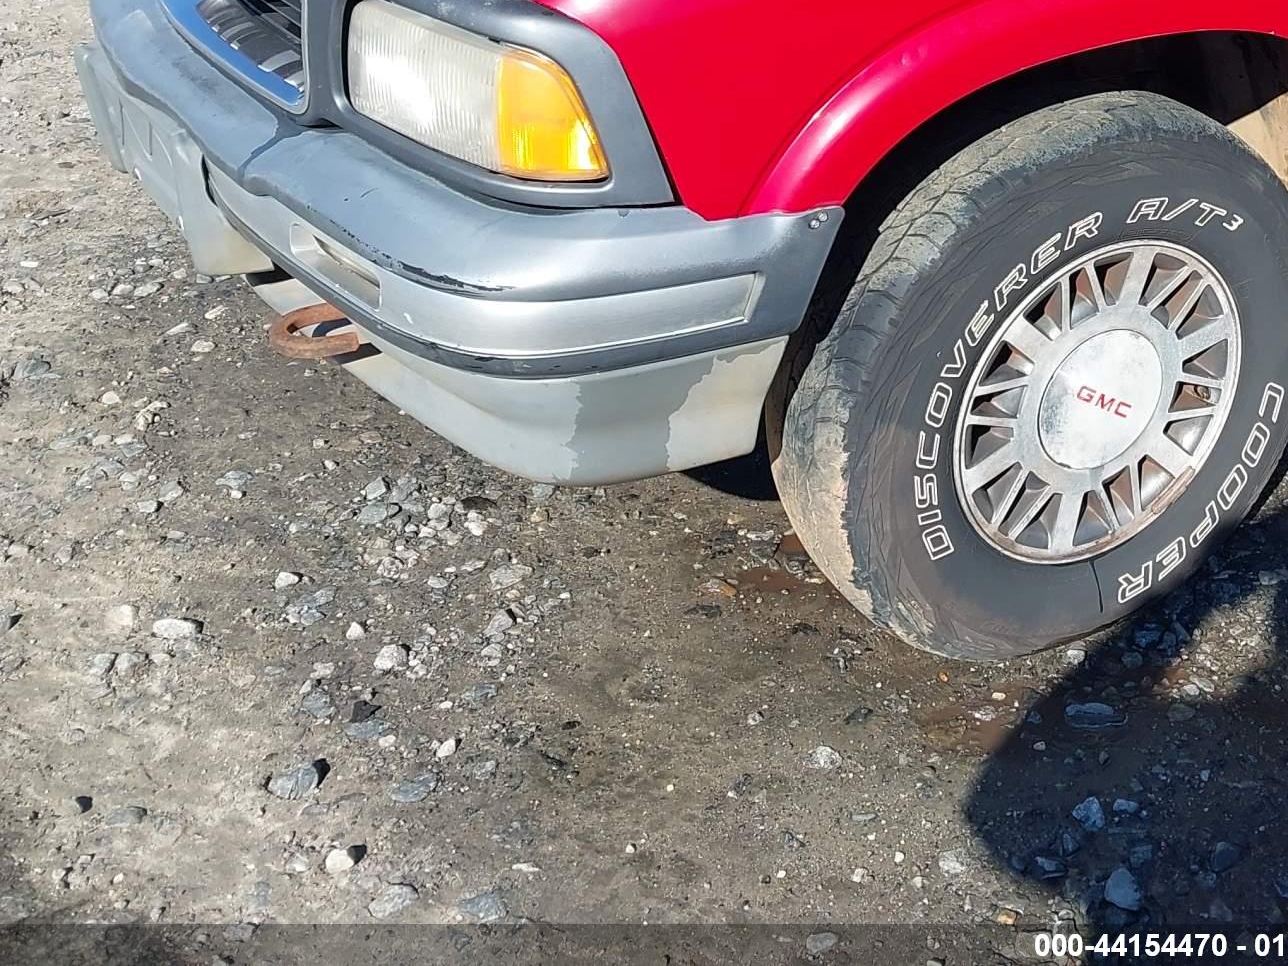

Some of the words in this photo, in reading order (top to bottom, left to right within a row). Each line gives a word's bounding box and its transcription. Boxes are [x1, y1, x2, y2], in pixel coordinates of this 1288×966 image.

[914, 212, 1103, 561] DISCOVERER
[1076, 385, 1132, 418] GMC
[1117, 382, 1286, 604] COOPER
